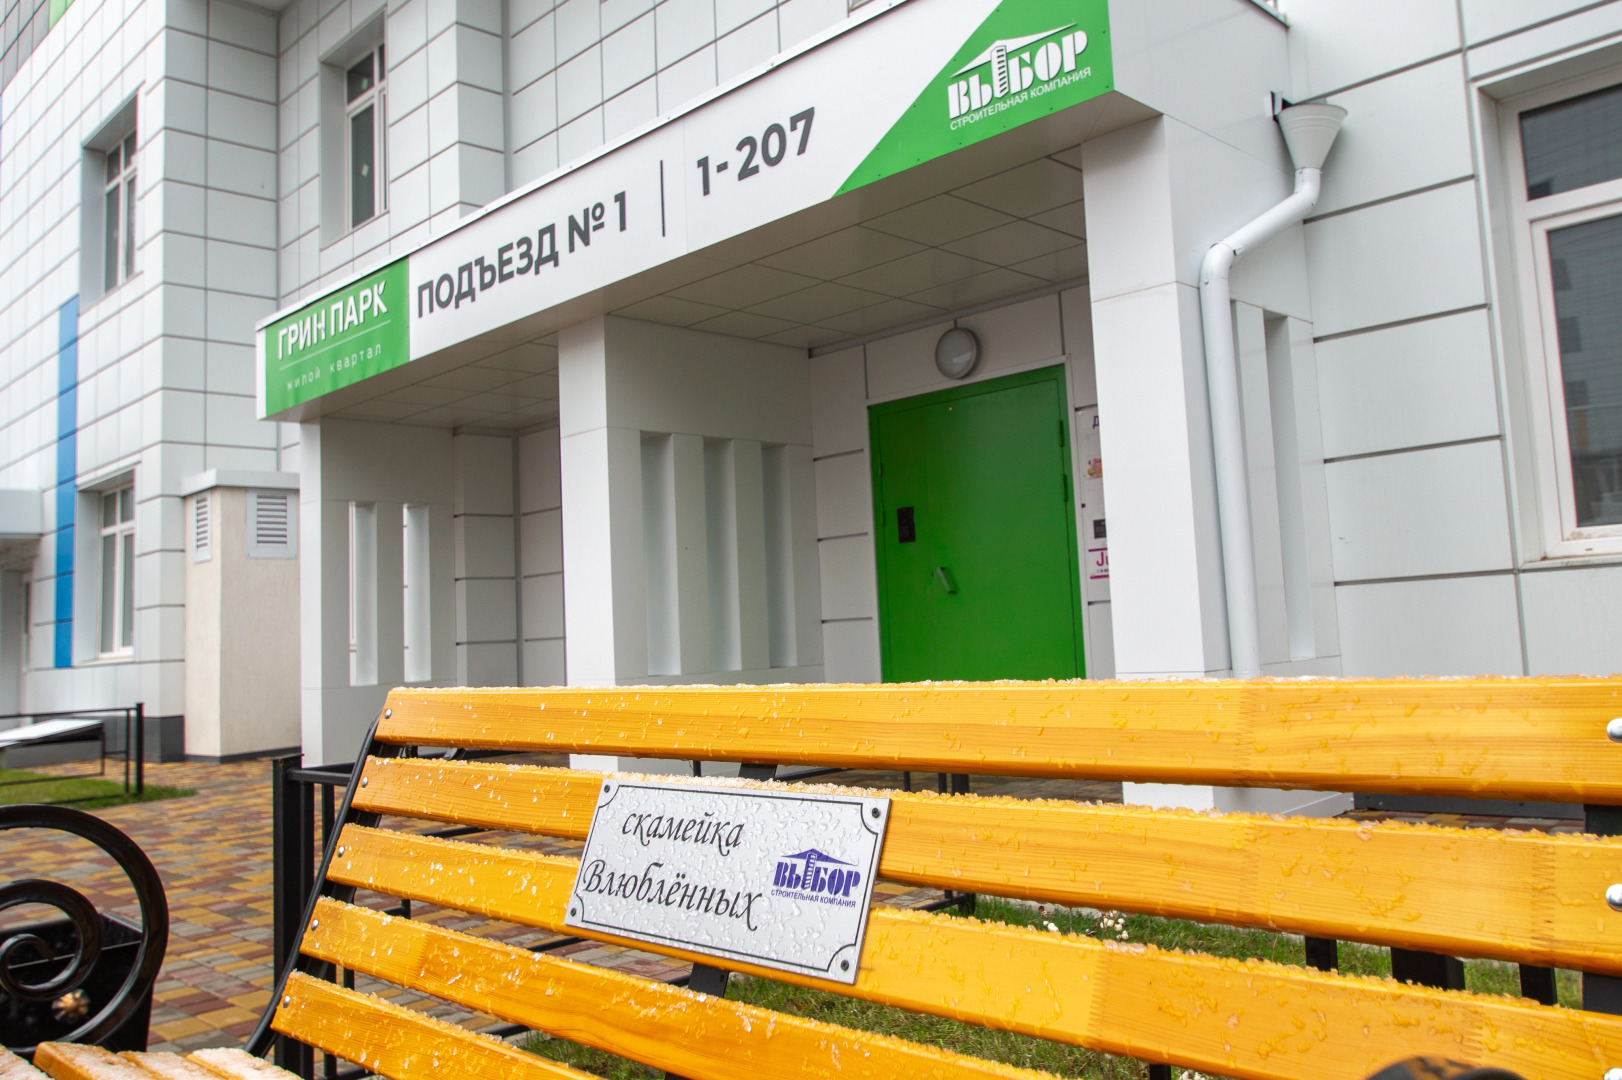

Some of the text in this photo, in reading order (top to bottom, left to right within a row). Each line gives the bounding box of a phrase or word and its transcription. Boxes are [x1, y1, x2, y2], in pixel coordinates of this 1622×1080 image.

[948, 30, 1088, 120] ВЫБОР
[950, 66, 1092, 131] СТРОИТЕЛЬНАЯ КОМПАНИЯ
[697, 106, 815, 197] 1-207
[417, 222, 560, 319] ПОДЪЕЗД
[278, 279, 388, 361] ГРИН ПАРК
[287, 343, 382, 392] жилой квартал
[621, 812, 745, 857] скамейка
[582, 859, 763, 932] Влюблённых
[770, 888, 857, 908] СТРОИТЕЛЬНАЯ КОМПАНИЯ
[773, 853, 861, 898] ВЫБОР
